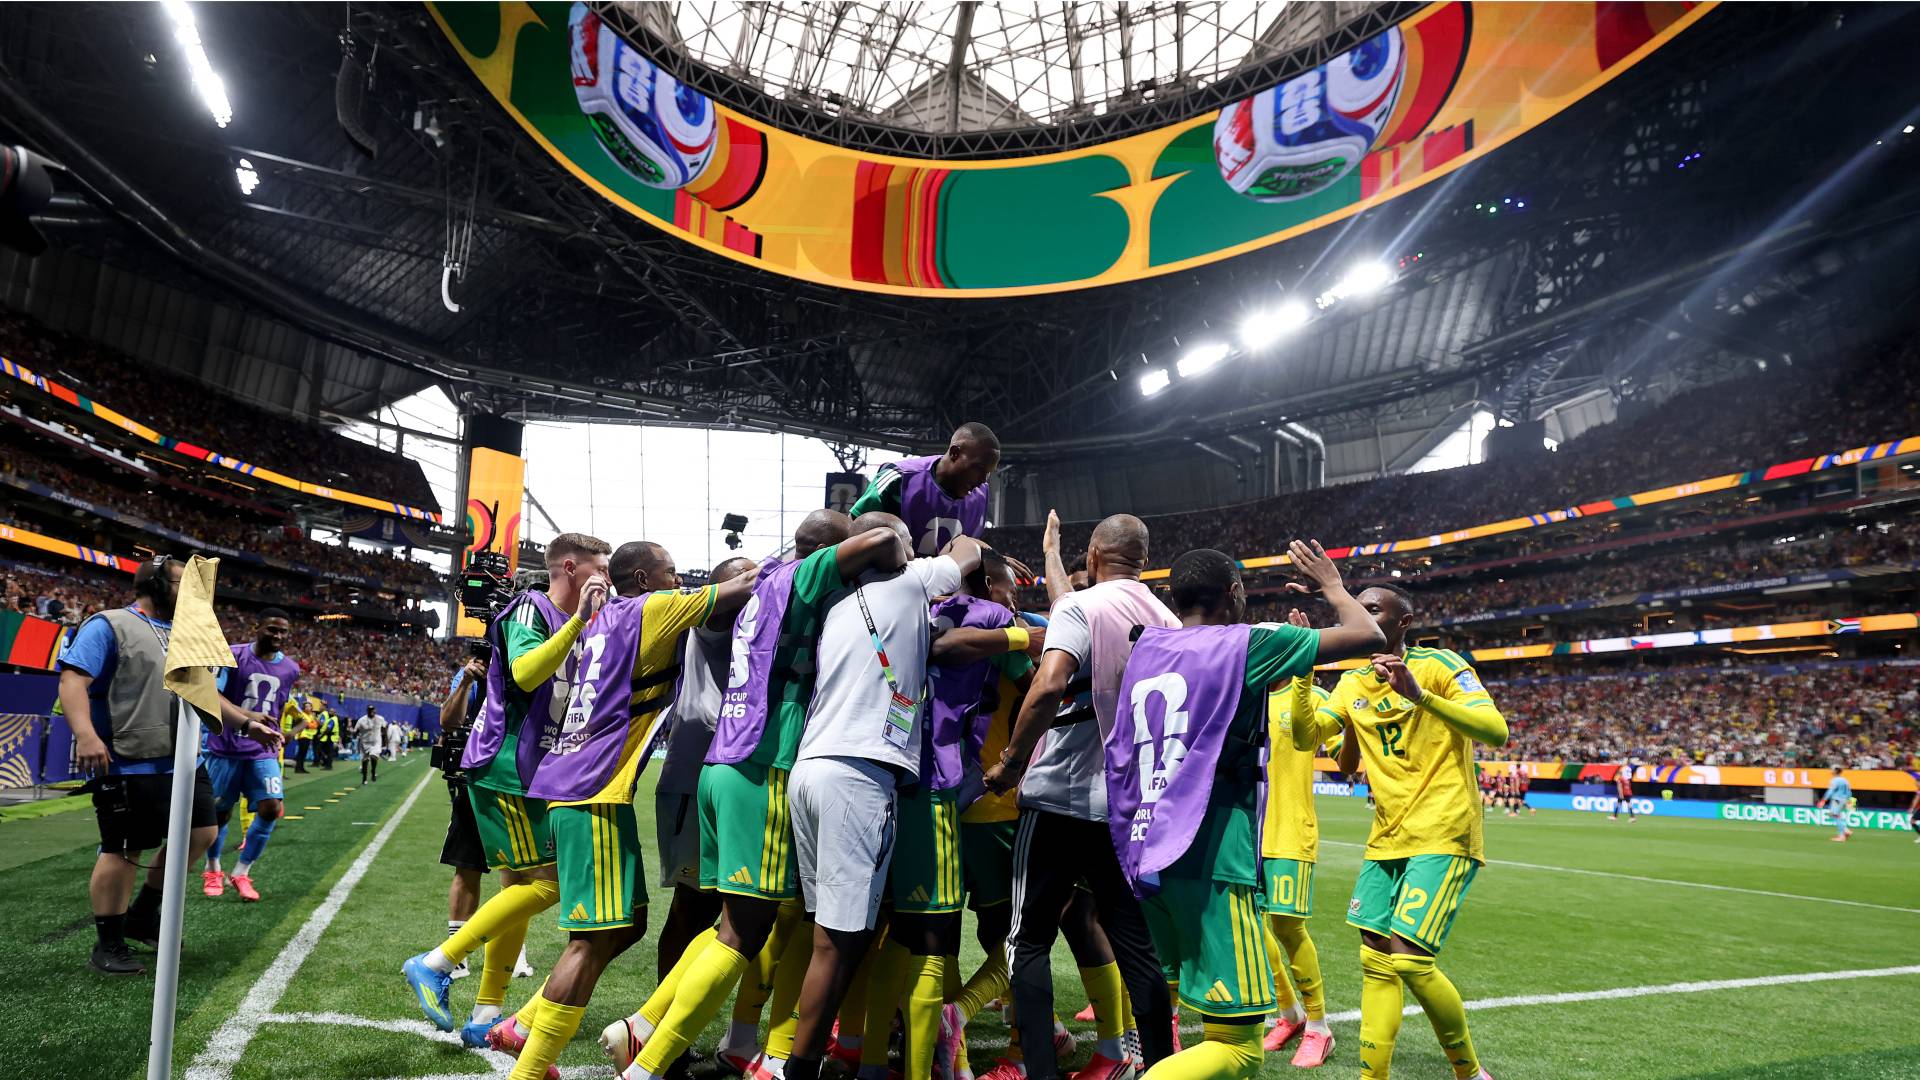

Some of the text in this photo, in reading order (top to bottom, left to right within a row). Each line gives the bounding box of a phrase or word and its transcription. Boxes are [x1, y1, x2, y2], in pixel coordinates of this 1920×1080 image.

[1833, 451, 1861, 466] GOL
[50, 491, 94, 511] ATLANTA
[323, 572, 365, 583] ATLANTA
[1700, 584, 1732, 595] WORLD
[1453, 612, 1495, 624] ATLANTA
[731, 693, 747, 701] CUP
[567, 713, 585, 724] FIFA
[1376, 722, 1406, 757] 12
[264, 777, 281, 794] 16
[1764, 769, 1812, 786] GOL
[1313, 783, 1351, 796] ramco
[1722, 803, 1793, 823] GLOBAL
[1793, 807, 1878, 828] ENEGY
[1272, 874, 1294, 905] 10
[1394, 883, 1428, 926] 12
